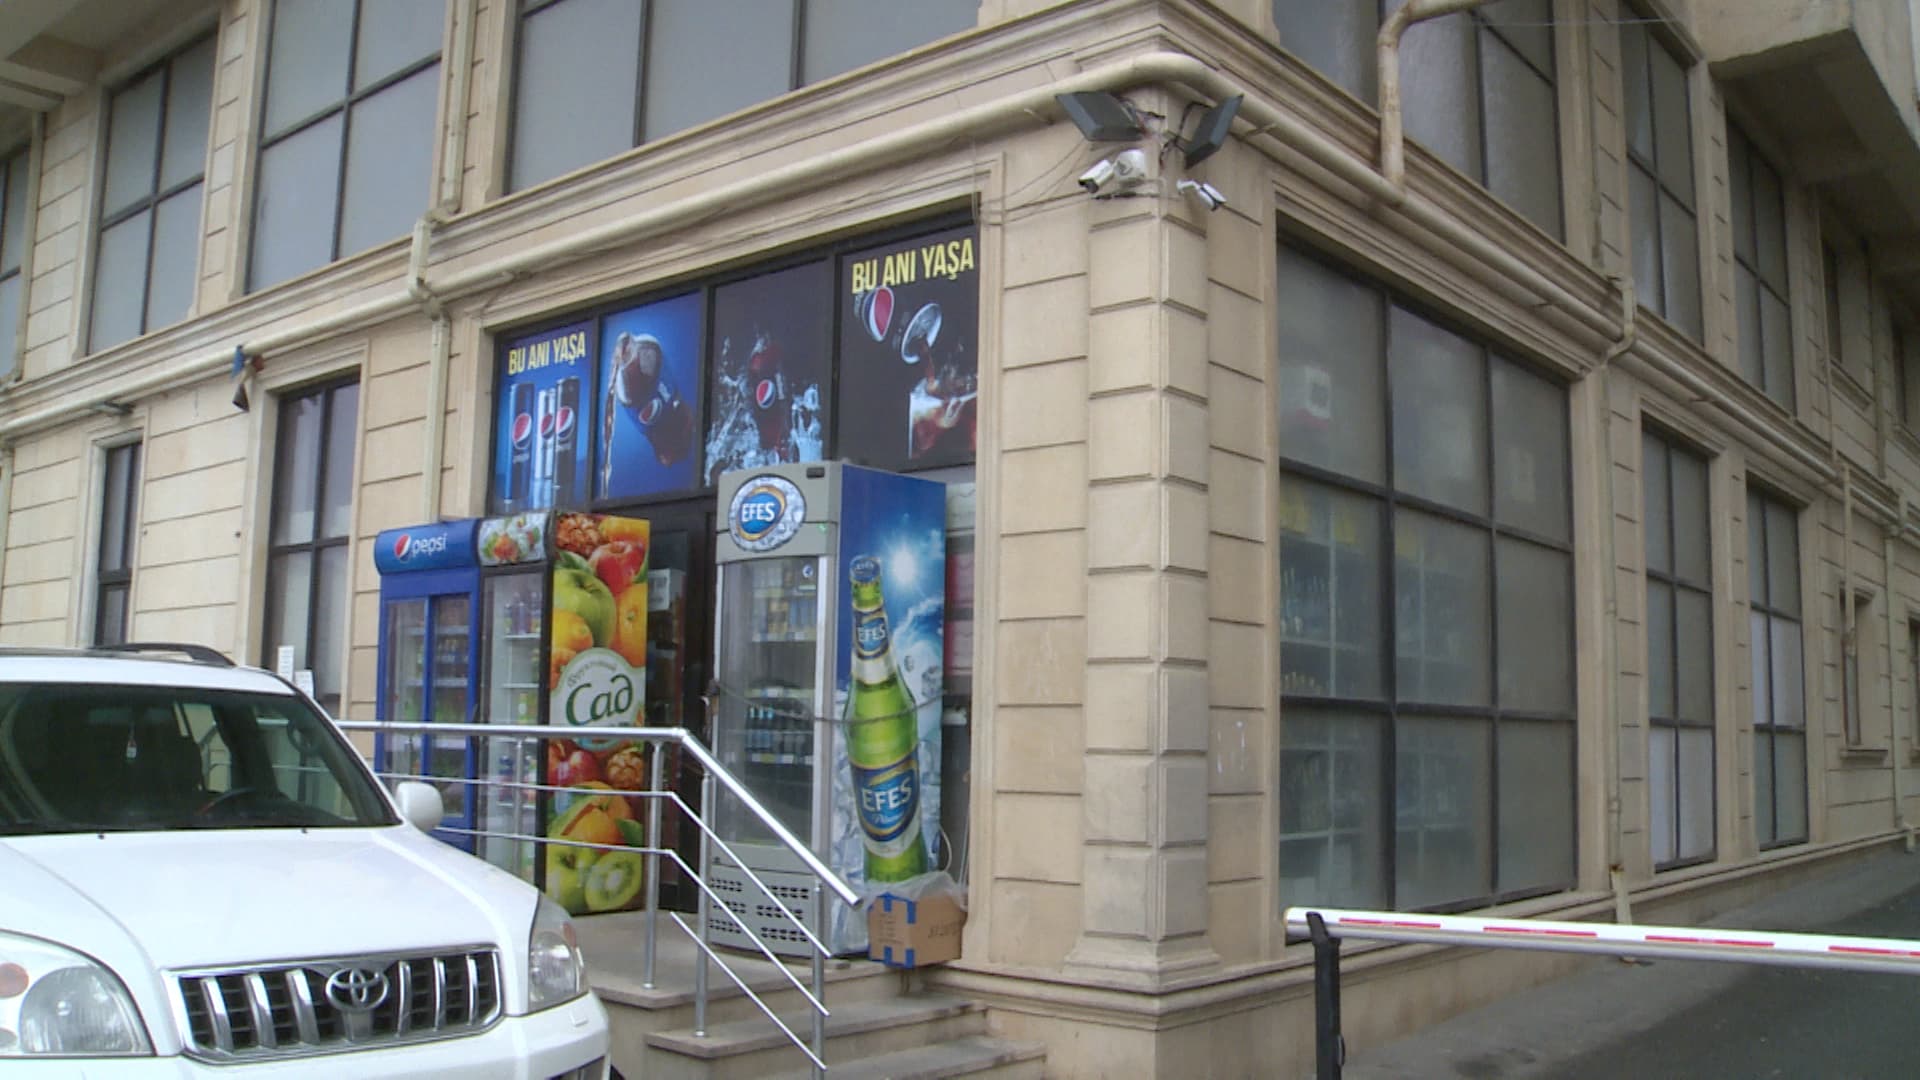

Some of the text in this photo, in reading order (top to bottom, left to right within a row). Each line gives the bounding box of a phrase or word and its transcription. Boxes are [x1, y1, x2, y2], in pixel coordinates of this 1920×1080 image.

[852, 238, 974, 294] BU ANI YAŞA
[508, 331, 586, 376] BU ANI YAŞA
[741, 502, 775, 522] EFES
[412, 532, 448, 558] pepsi
[857, 623, 887, 642] EFES
[862, 776, 912, 812] EFES
